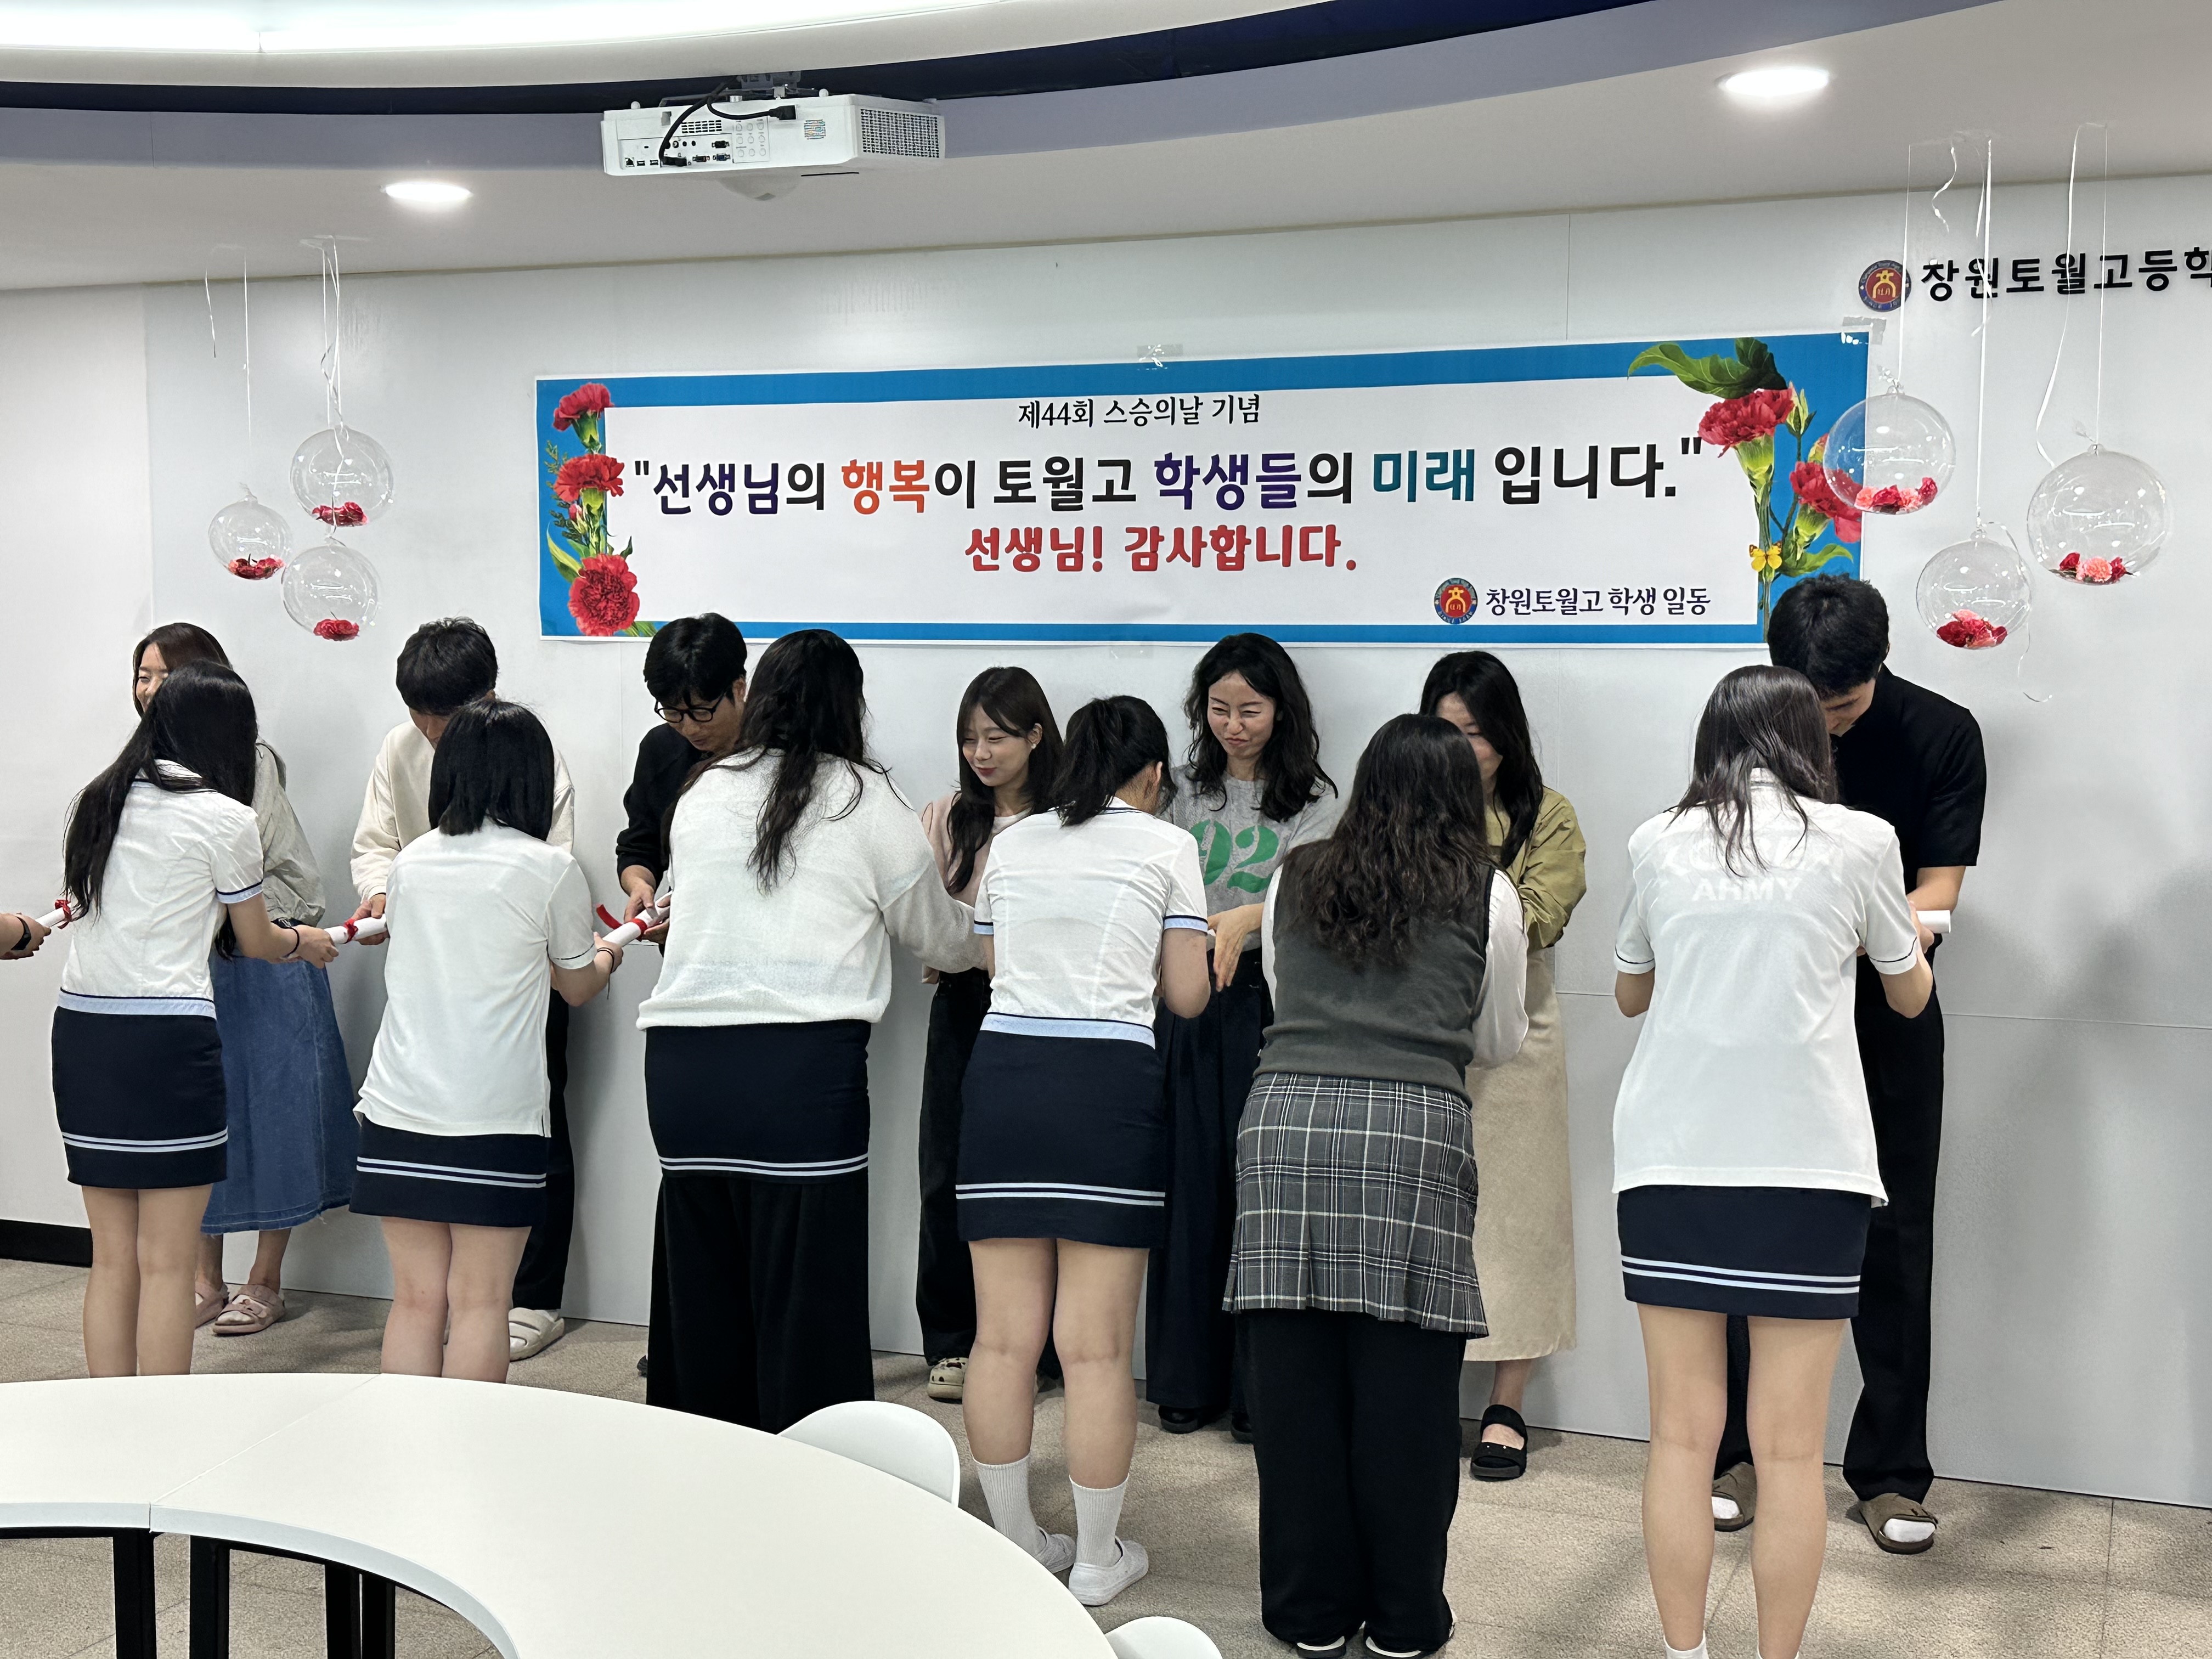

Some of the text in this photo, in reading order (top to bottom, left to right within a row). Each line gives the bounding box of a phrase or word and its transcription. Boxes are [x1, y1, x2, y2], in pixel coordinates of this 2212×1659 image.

[1018, 393, 1260, 429] 제44회 스승의날 기념
[635, 437, 1702, 516] "선생님의 행복이 토월고 학생들의 미래 입니다."
[965, 523, 1356, 572] 선생님! 감사합니다.
[1486, 588, 1604, 616] 창원토월고
[1607, 587, 1656, 616] 학생
[1663, 586, 1711, 616] 일동
